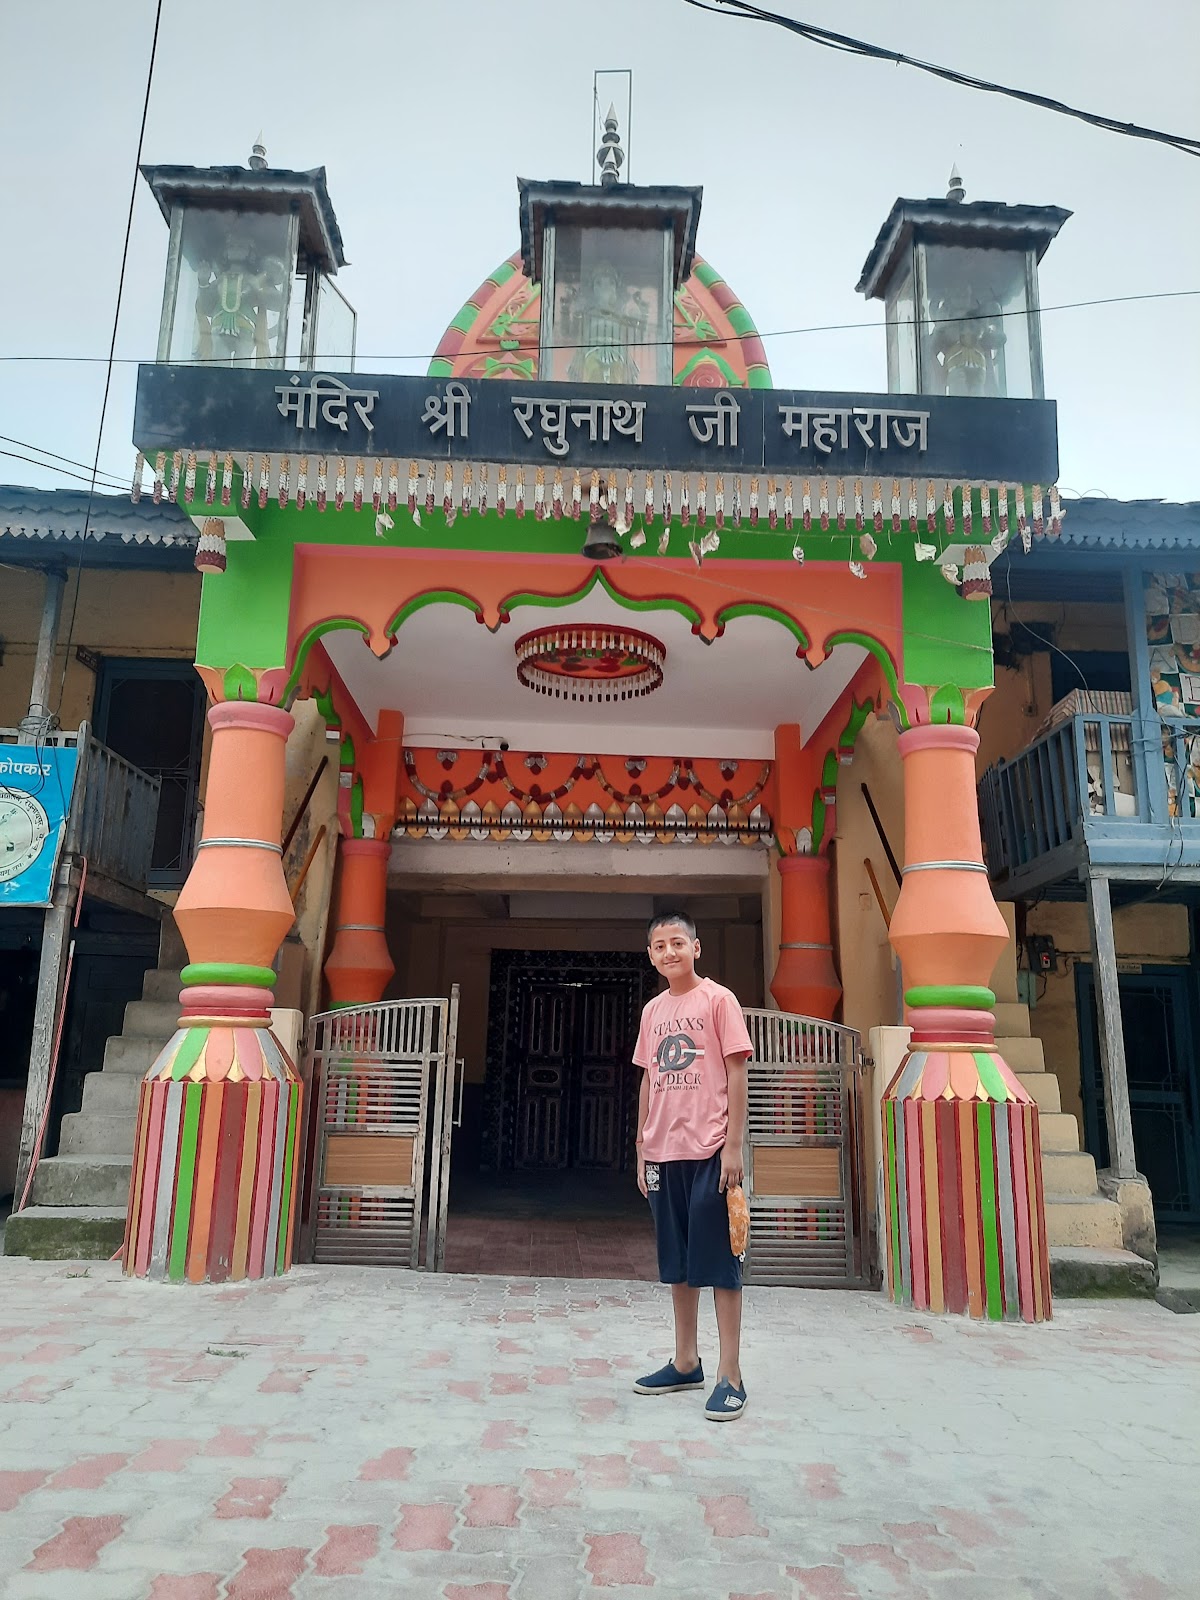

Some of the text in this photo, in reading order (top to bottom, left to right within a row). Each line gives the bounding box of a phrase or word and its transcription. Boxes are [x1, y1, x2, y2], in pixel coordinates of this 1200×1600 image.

[274, 374, 931, 457] मंदिर श्री रघुनाथ जी महाराज
[666, 1072, 702, 1085] DECK
